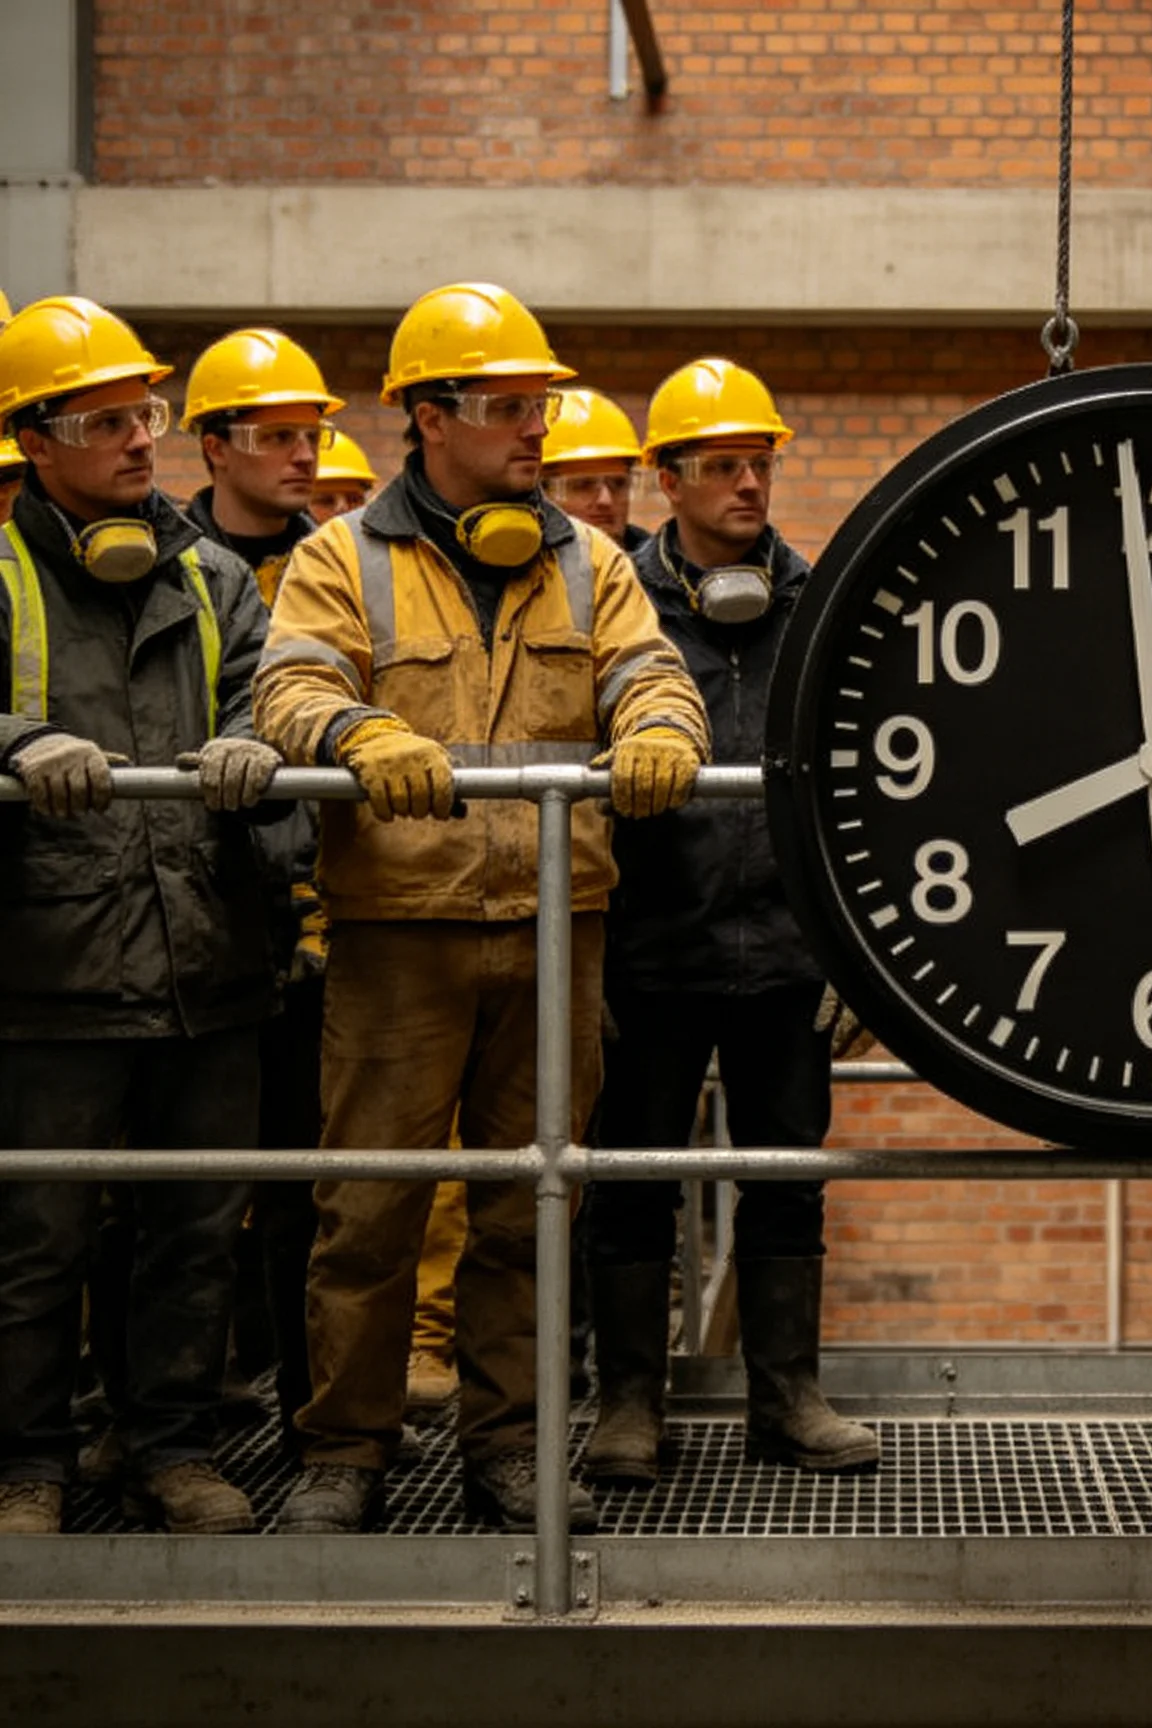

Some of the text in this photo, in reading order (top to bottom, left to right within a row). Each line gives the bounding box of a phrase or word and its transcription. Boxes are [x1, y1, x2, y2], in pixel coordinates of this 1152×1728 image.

[998, 506, 1069, 590] 11
[902, 600, 1001, 685] 10
[873, 715, 936, 800] 9
[910, 839, 974, 924] 8
[1005, 930, 1067, 1011] 7
